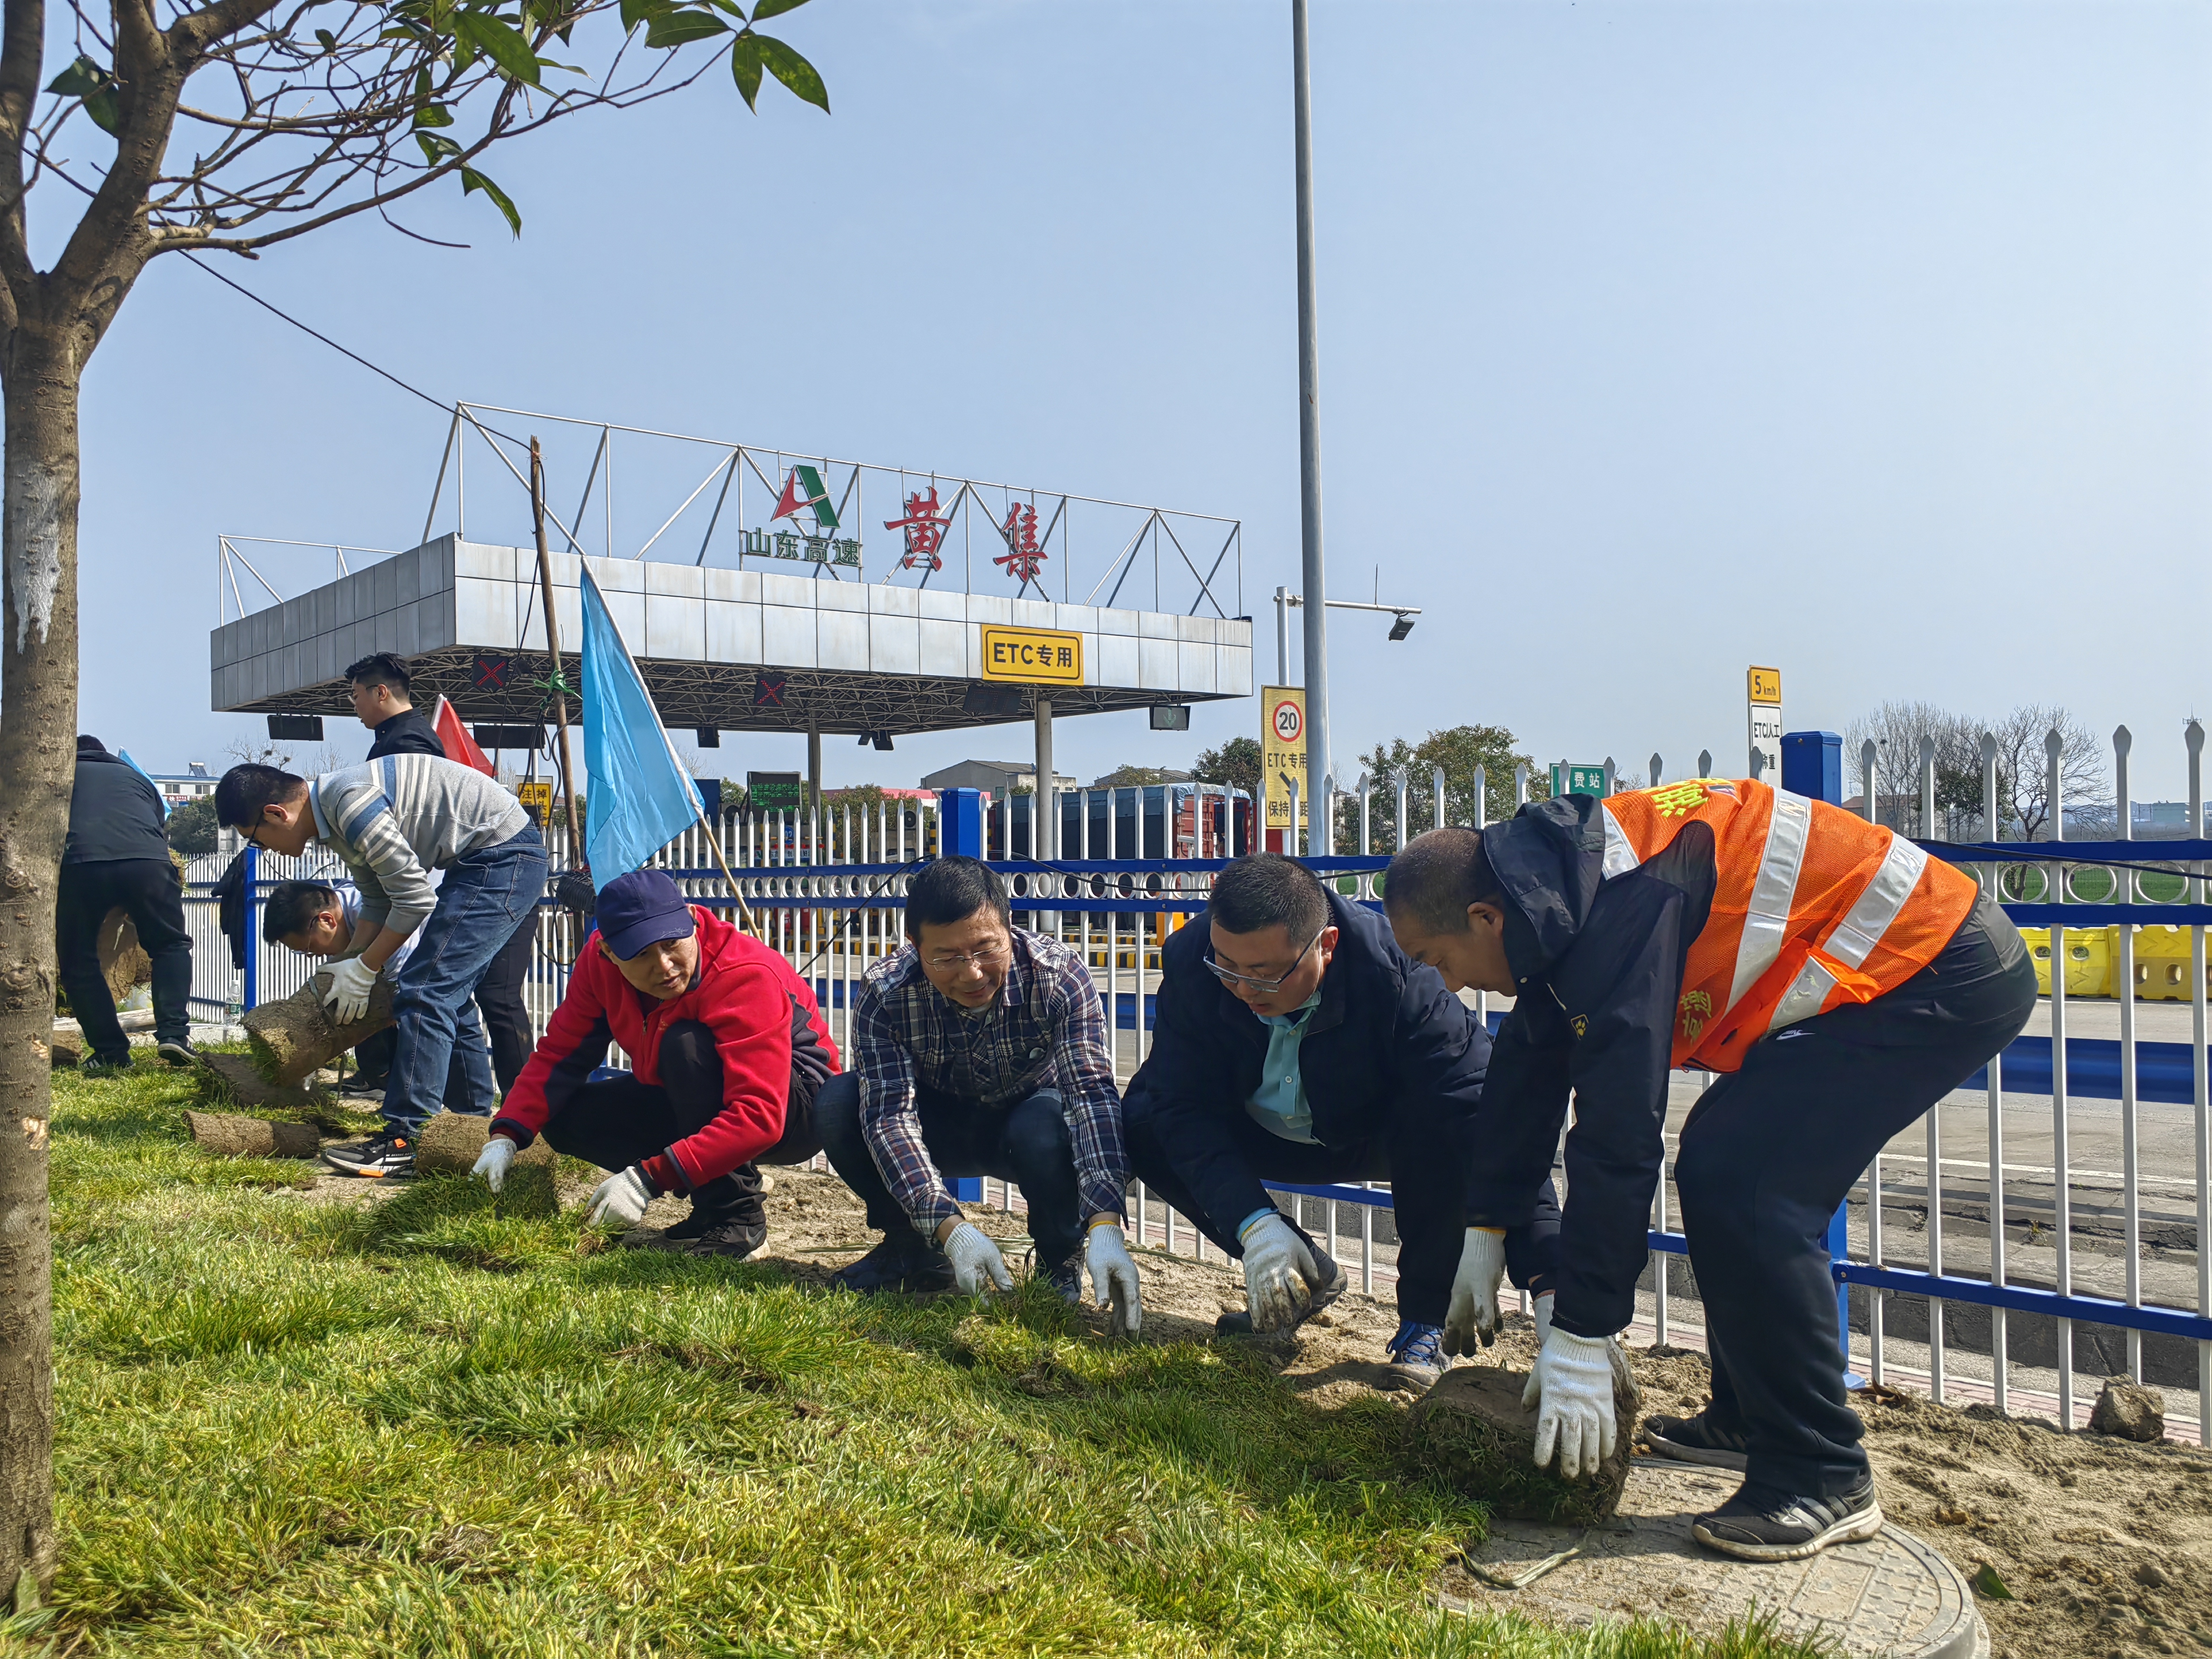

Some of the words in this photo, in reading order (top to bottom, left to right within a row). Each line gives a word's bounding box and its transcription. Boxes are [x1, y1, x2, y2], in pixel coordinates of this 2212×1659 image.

[746, 527, 859, 566] 山东高速
[994, 642, 1072, 668] ETC专用
[1755, 675, 1762, 694] 5
[1279, 712, 1297, 730] 20
[1267, 753, 1306, 768] ETC专用
[1559, 772, 1600, 788] 费站
[1269, 801, 1308, 817] 保持距
